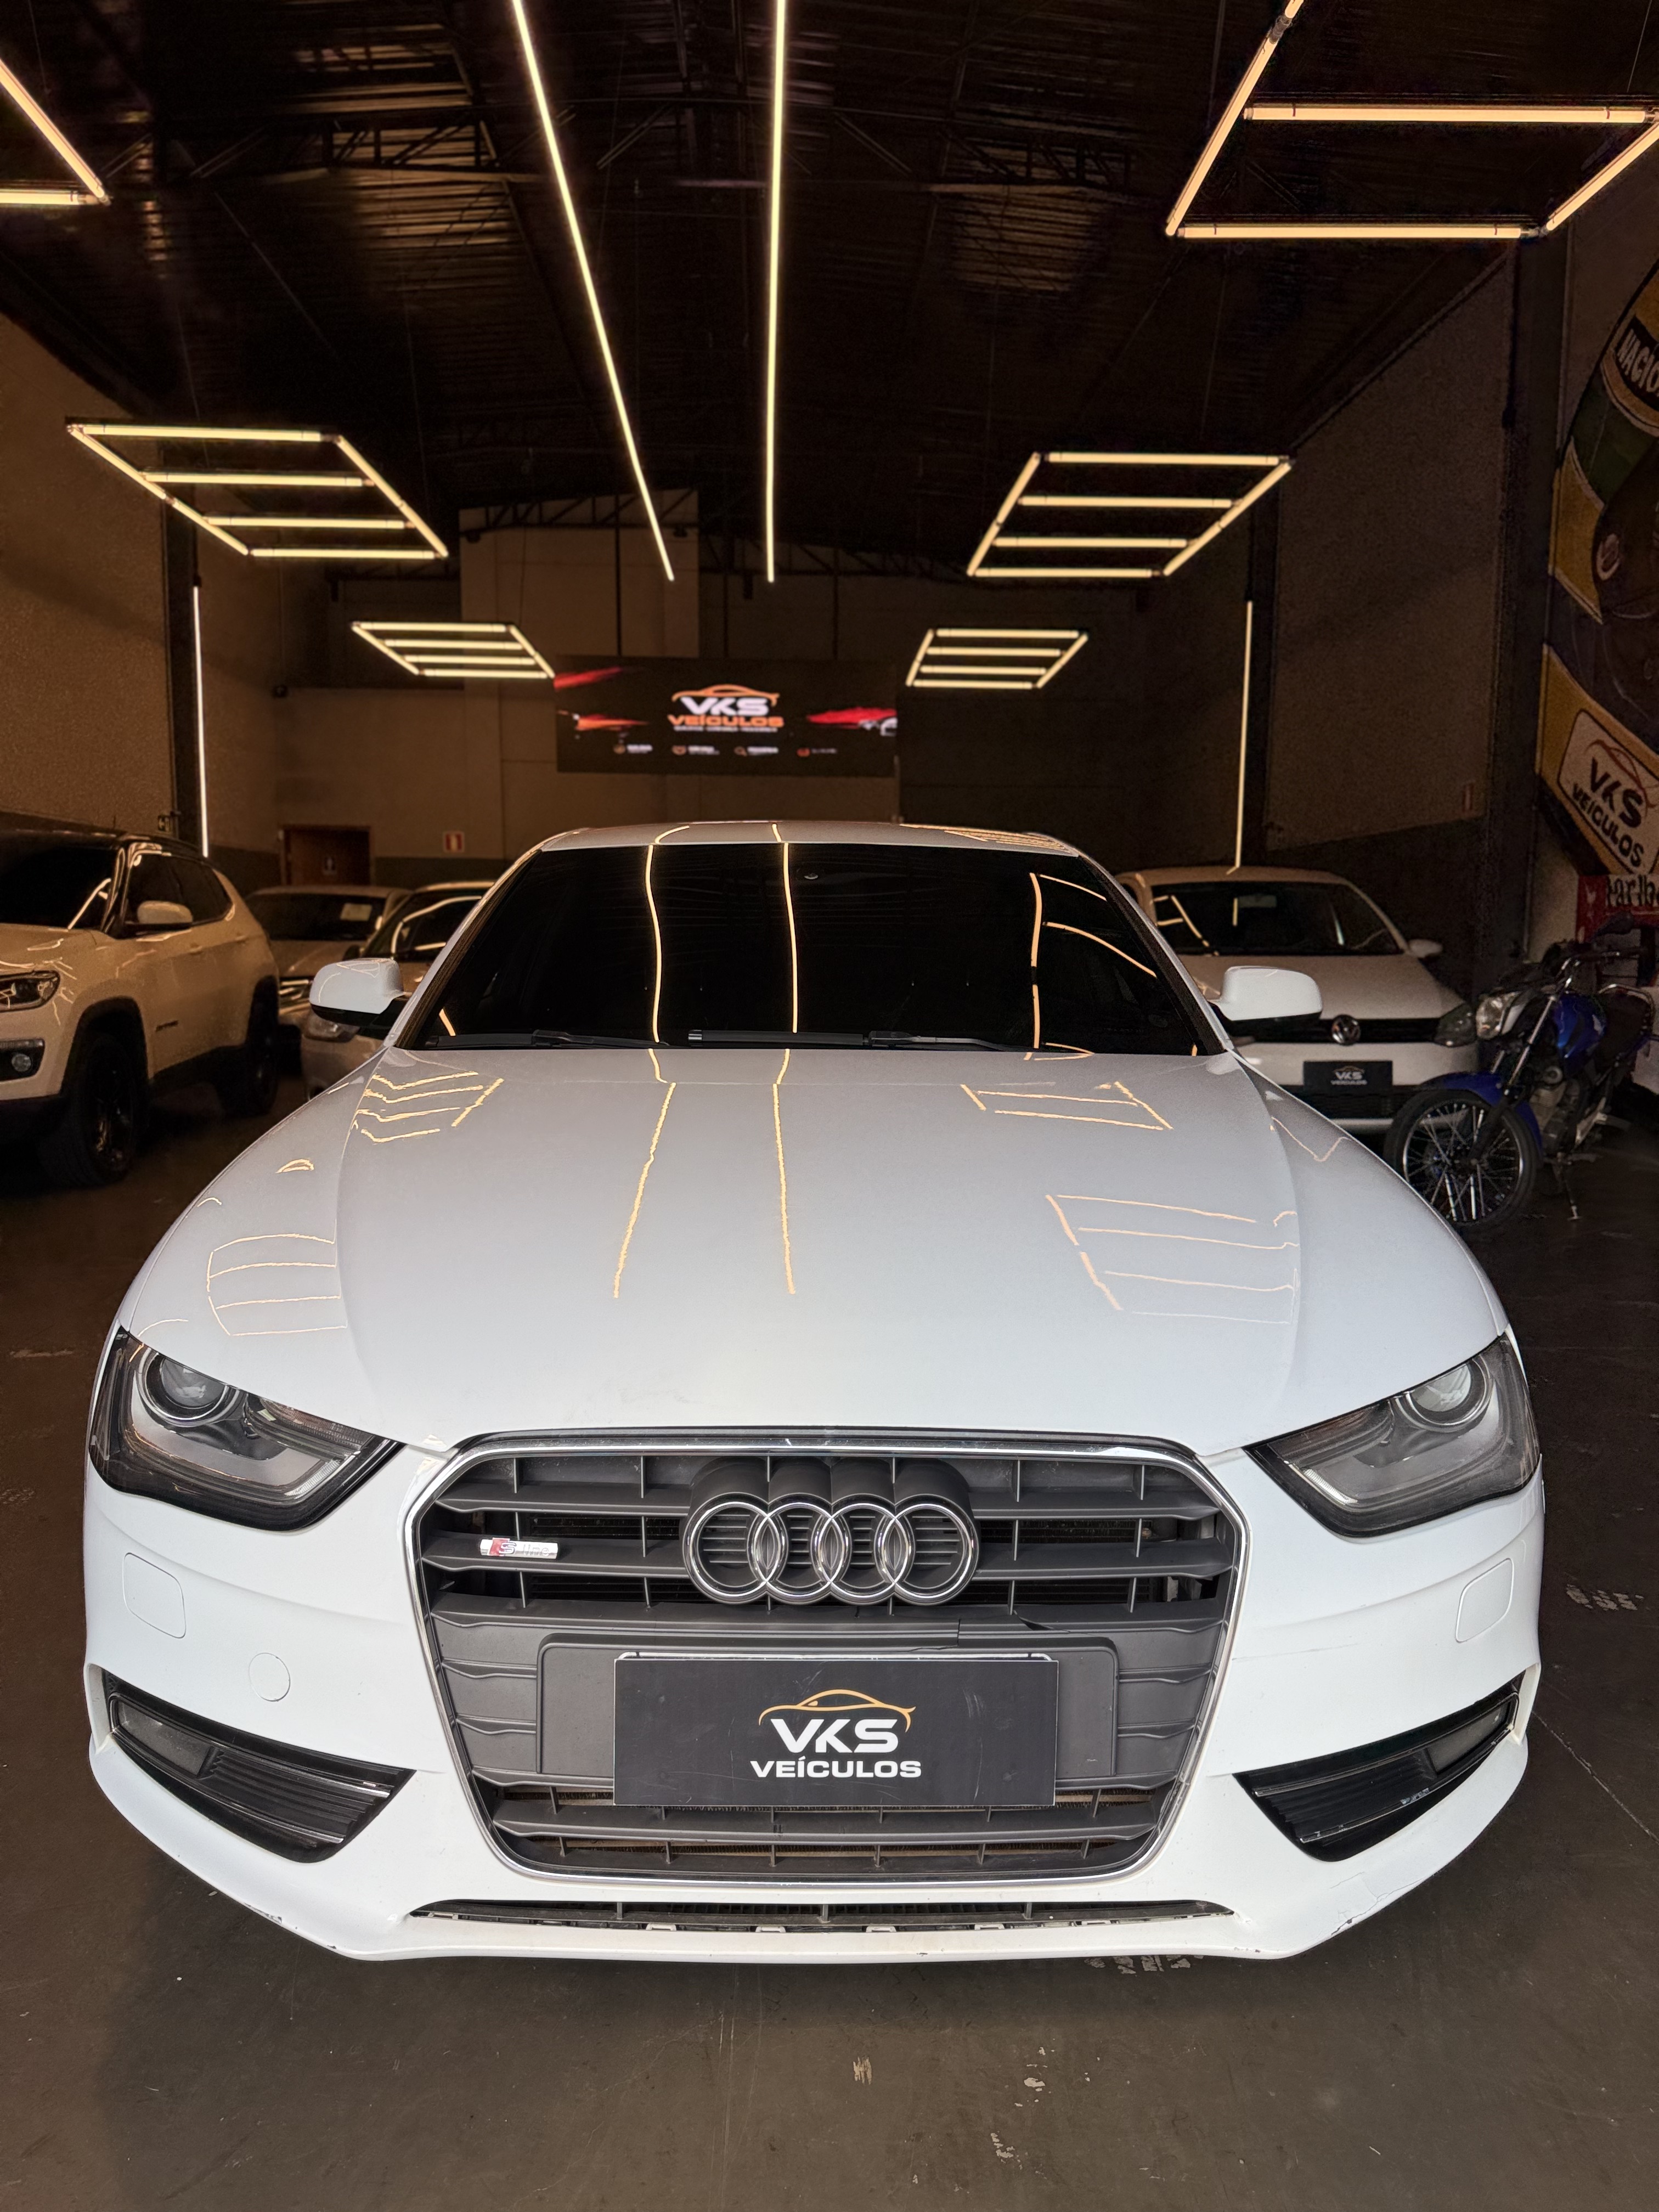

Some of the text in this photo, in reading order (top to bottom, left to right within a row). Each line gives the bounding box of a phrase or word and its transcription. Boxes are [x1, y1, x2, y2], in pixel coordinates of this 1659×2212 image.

[1616, 328, 1659, 397] NACIO
[680, 696, 769, 715] VKS
[1590, 756, 1643, 828] VKS
[1606, 874, 1659, 906] arlb
[1334, 1071, 1363, 1080] VKS
[770, 1718, 899, 1753] VKS
[750, 1756, 922, 1778] VEÍCULOS
